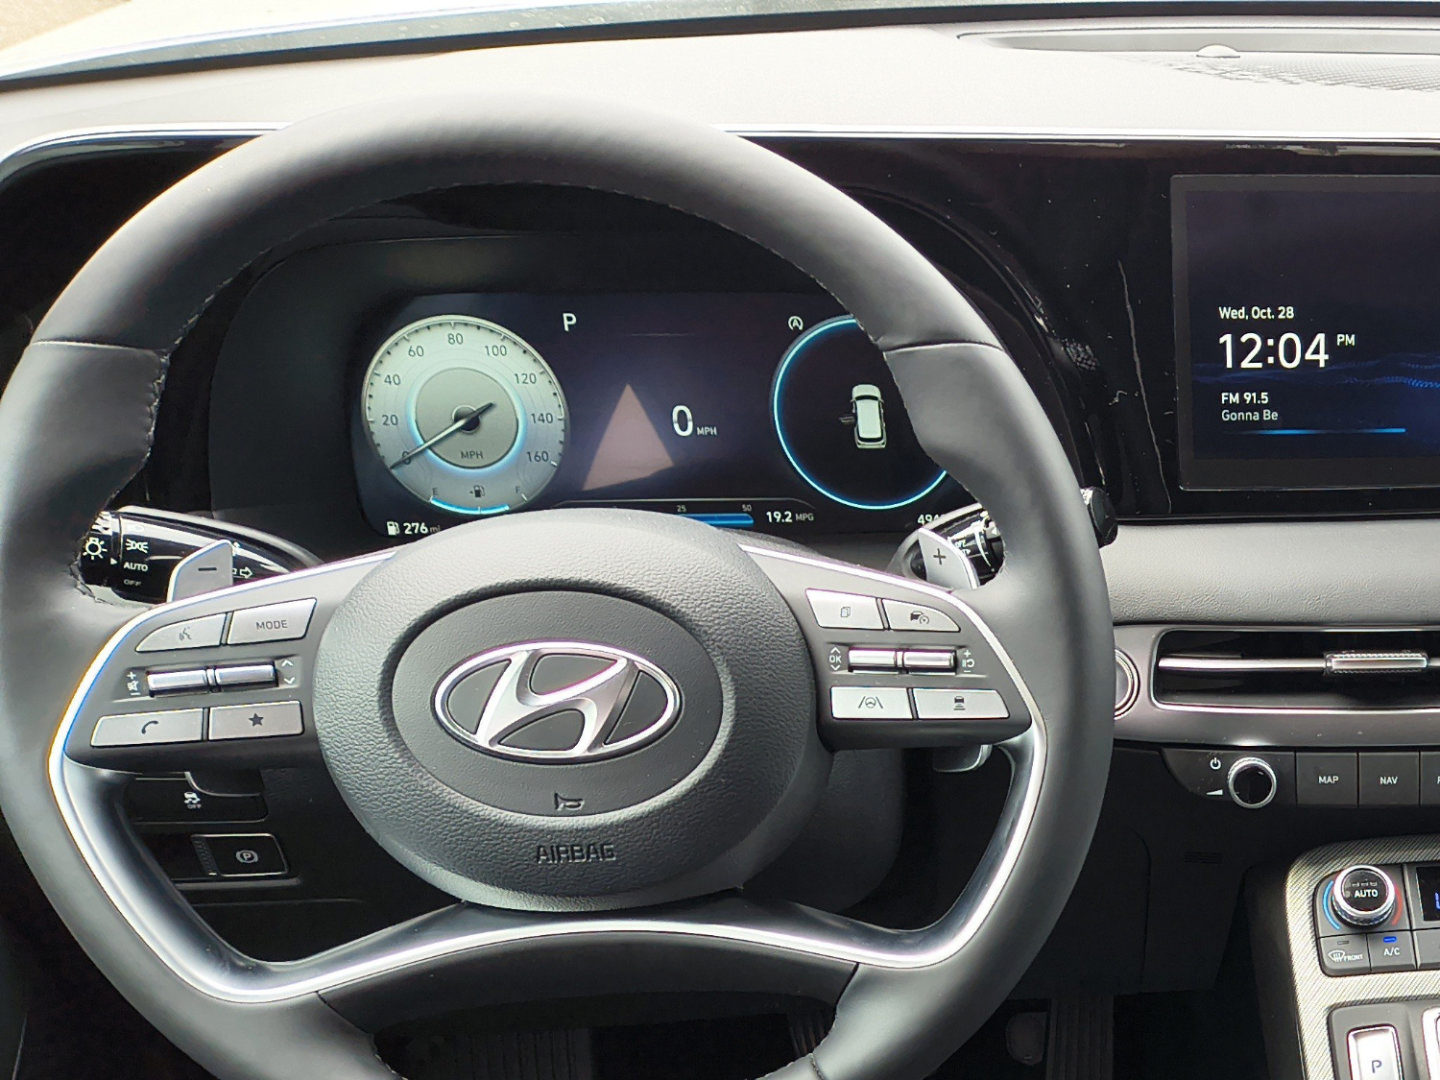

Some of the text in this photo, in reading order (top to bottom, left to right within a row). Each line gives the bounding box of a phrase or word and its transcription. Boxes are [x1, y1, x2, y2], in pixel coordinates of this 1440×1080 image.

[1219, 306, 1295, 320] Wed, Oct. 28
[562, 313, 577, 331] P
[447, 333, 464, 345] 80
[408, 346, 424, 358] 60
[484, 345, 508, 357] 100
[1218, 332, 1356, 370] 12:04 PM
[384, 374, 401, 387] 40
[514, 373, 537, 385] 120
[1221, 392, 1269, 404] FM 91.5
[382, 414, 399, 427] 20
[531, 413, 553, 425] 140
[672, 405, 718, 437] 0 MPH
[1221, 410, 1279, 421] Gonna Be
[460, 450, 484, 460] MPH
[526, 451, 549, 463] 160
[676, 505, 688, 514] 25
[741, 504, 753, 514] 50
[766, 511, 815, 524] 19.2 MPG
[403, 522, 429, 535] 276
[123, 561, 149, 573] AUTO
[255, 619, 289, 633] MODE
[829, 654, 842, 664] OK
[1318, 774, 1339, 785] MAP
[1379, 775, 1398, 786] NAV
[536, 843, 617, 864] AIRBAG
[1353, 888, 1379, 899] AUTO
[1383, 948, 1400, 957] A/C
[1371, 1059, 1383, 1074] P
